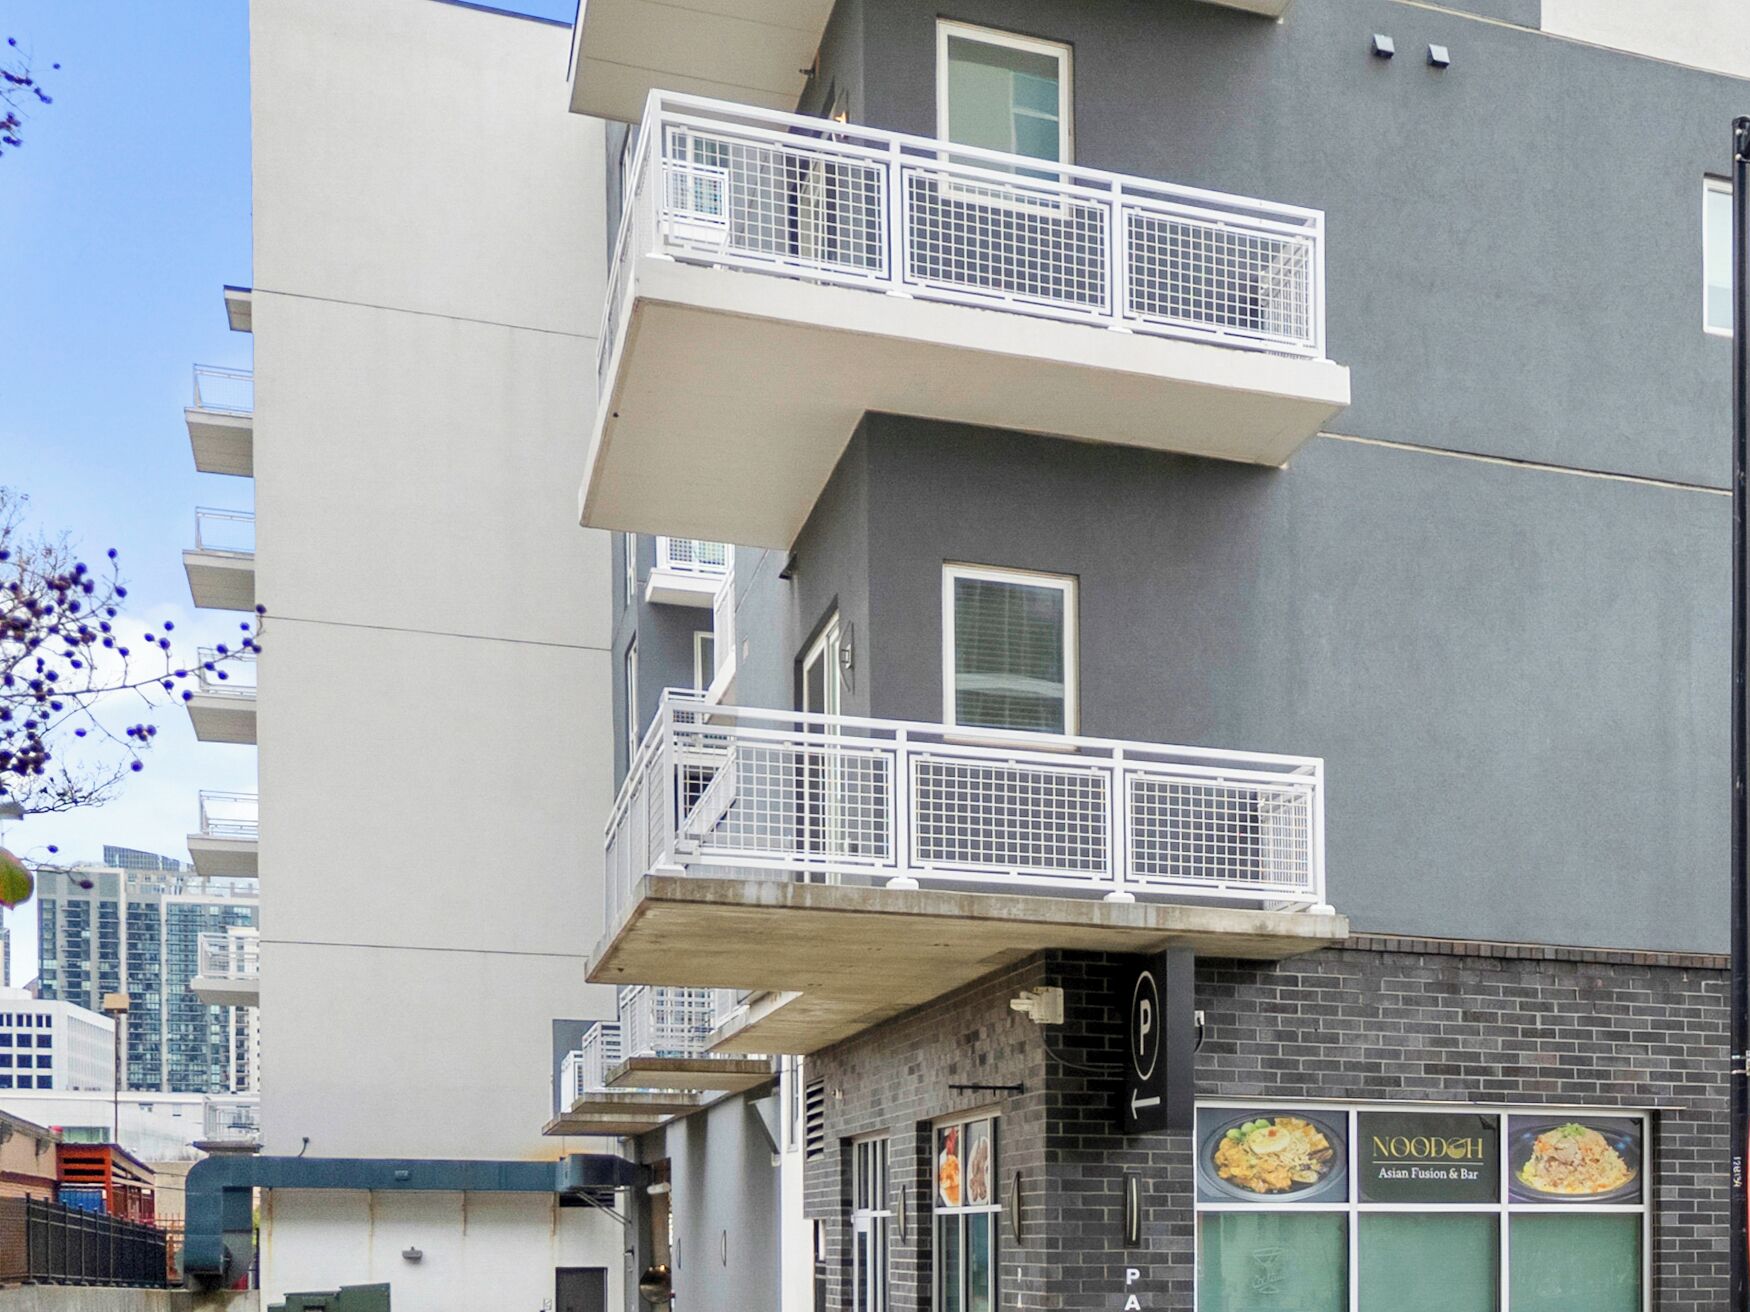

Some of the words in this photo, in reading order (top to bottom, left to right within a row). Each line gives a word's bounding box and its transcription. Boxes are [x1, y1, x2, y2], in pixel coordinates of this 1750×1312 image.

[1140, 999, 1152, 1055] P
[1378, 1168, 1409, 1179] Asian
[1411, 1167, 1447, 1179] Fusion
[1449, 1168, 1458, 1179] &
[1460, 1168, 1478, 1180] Bar
